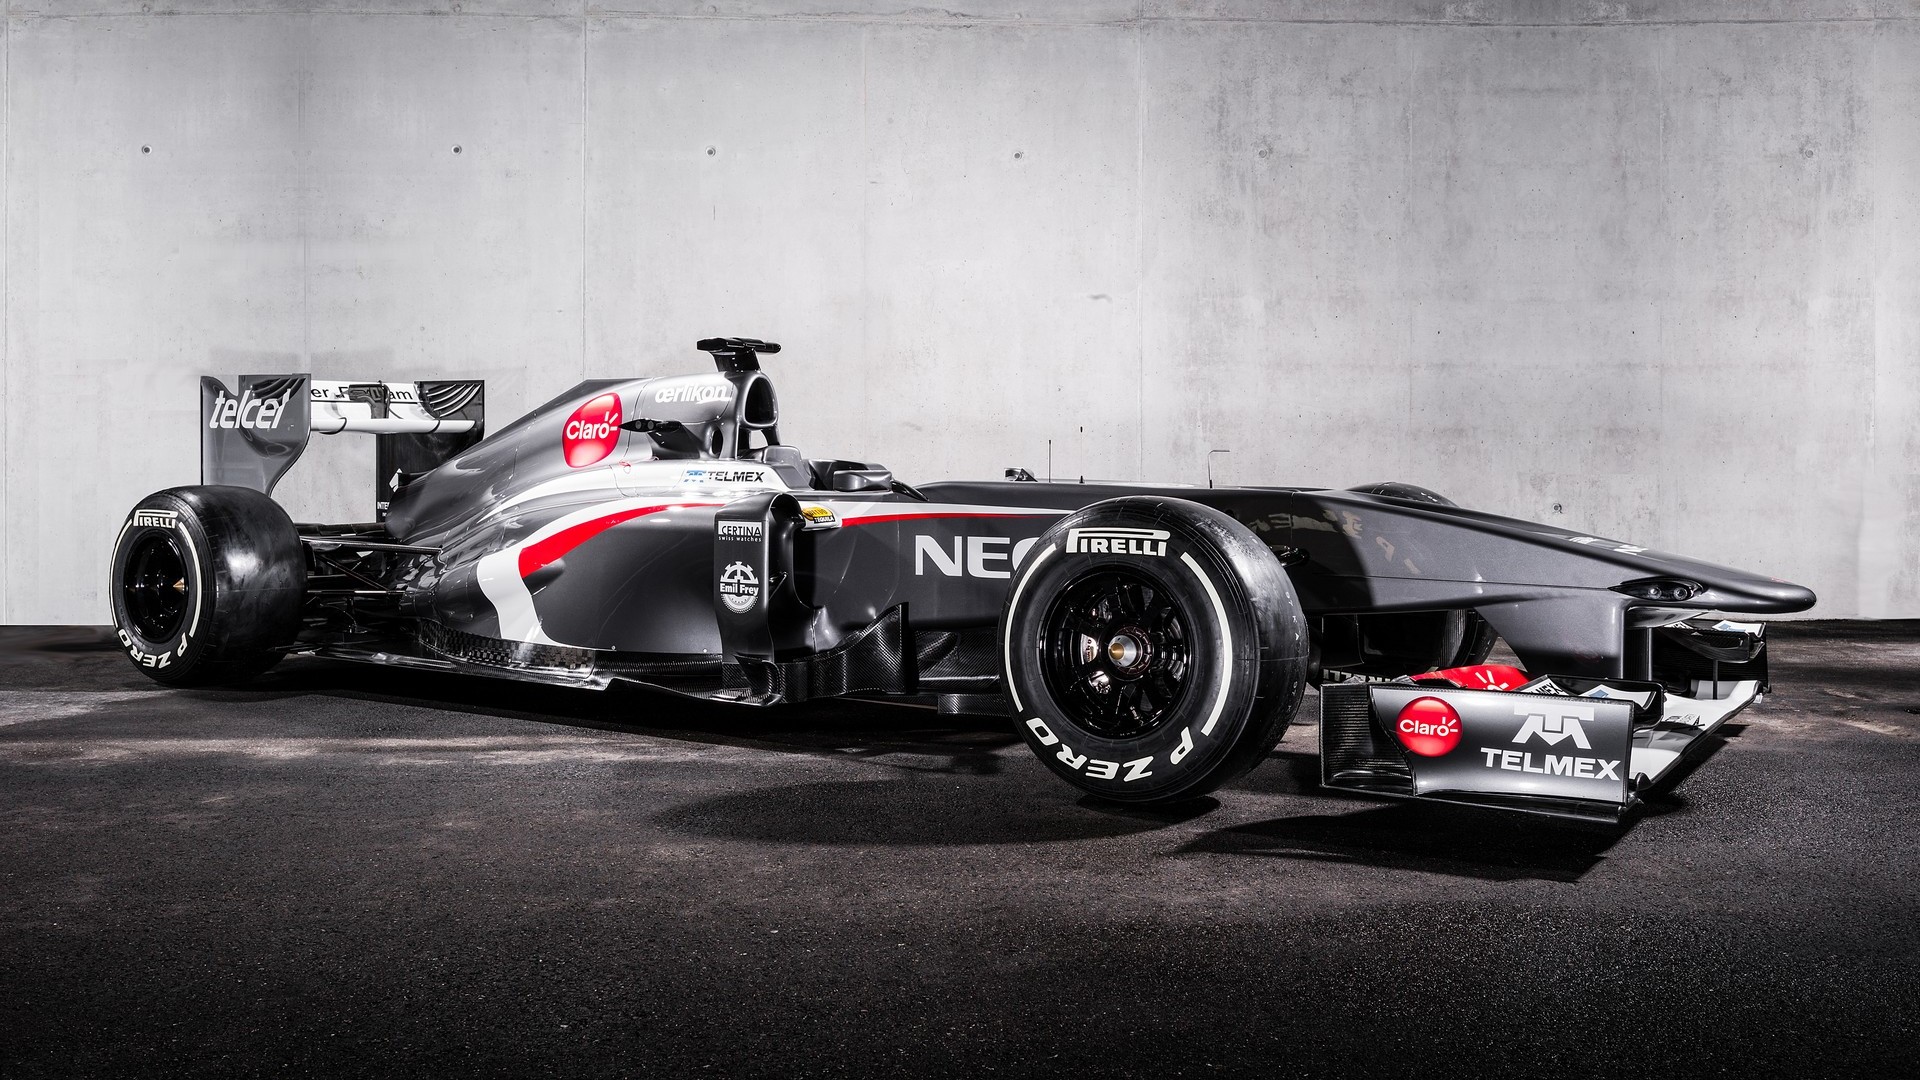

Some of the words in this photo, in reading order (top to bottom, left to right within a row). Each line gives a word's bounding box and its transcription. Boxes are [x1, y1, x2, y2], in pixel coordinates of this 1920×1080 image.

[209, 389, 291, 429] telcel
[566, 416, 614, 440] Claro
[708, 471, 765, 483] TELMEX
[133, 509, 178, 529] PIRELLI
[721, 525, 762, 536] CERTINA
[1065, 526, 1171, 557] PIRELLI
[720, 583, 738, 593] Emil
[739, 584, 759, 596] Frey
[118, 628, 171, 669] ZERO
[1399, 717, 1455, 737] Claro
[1025, 717, 1154, 782] ZERO
[1169, 726, 1194, 765] P
[1480, 747, 1621, 781] TELMEX
